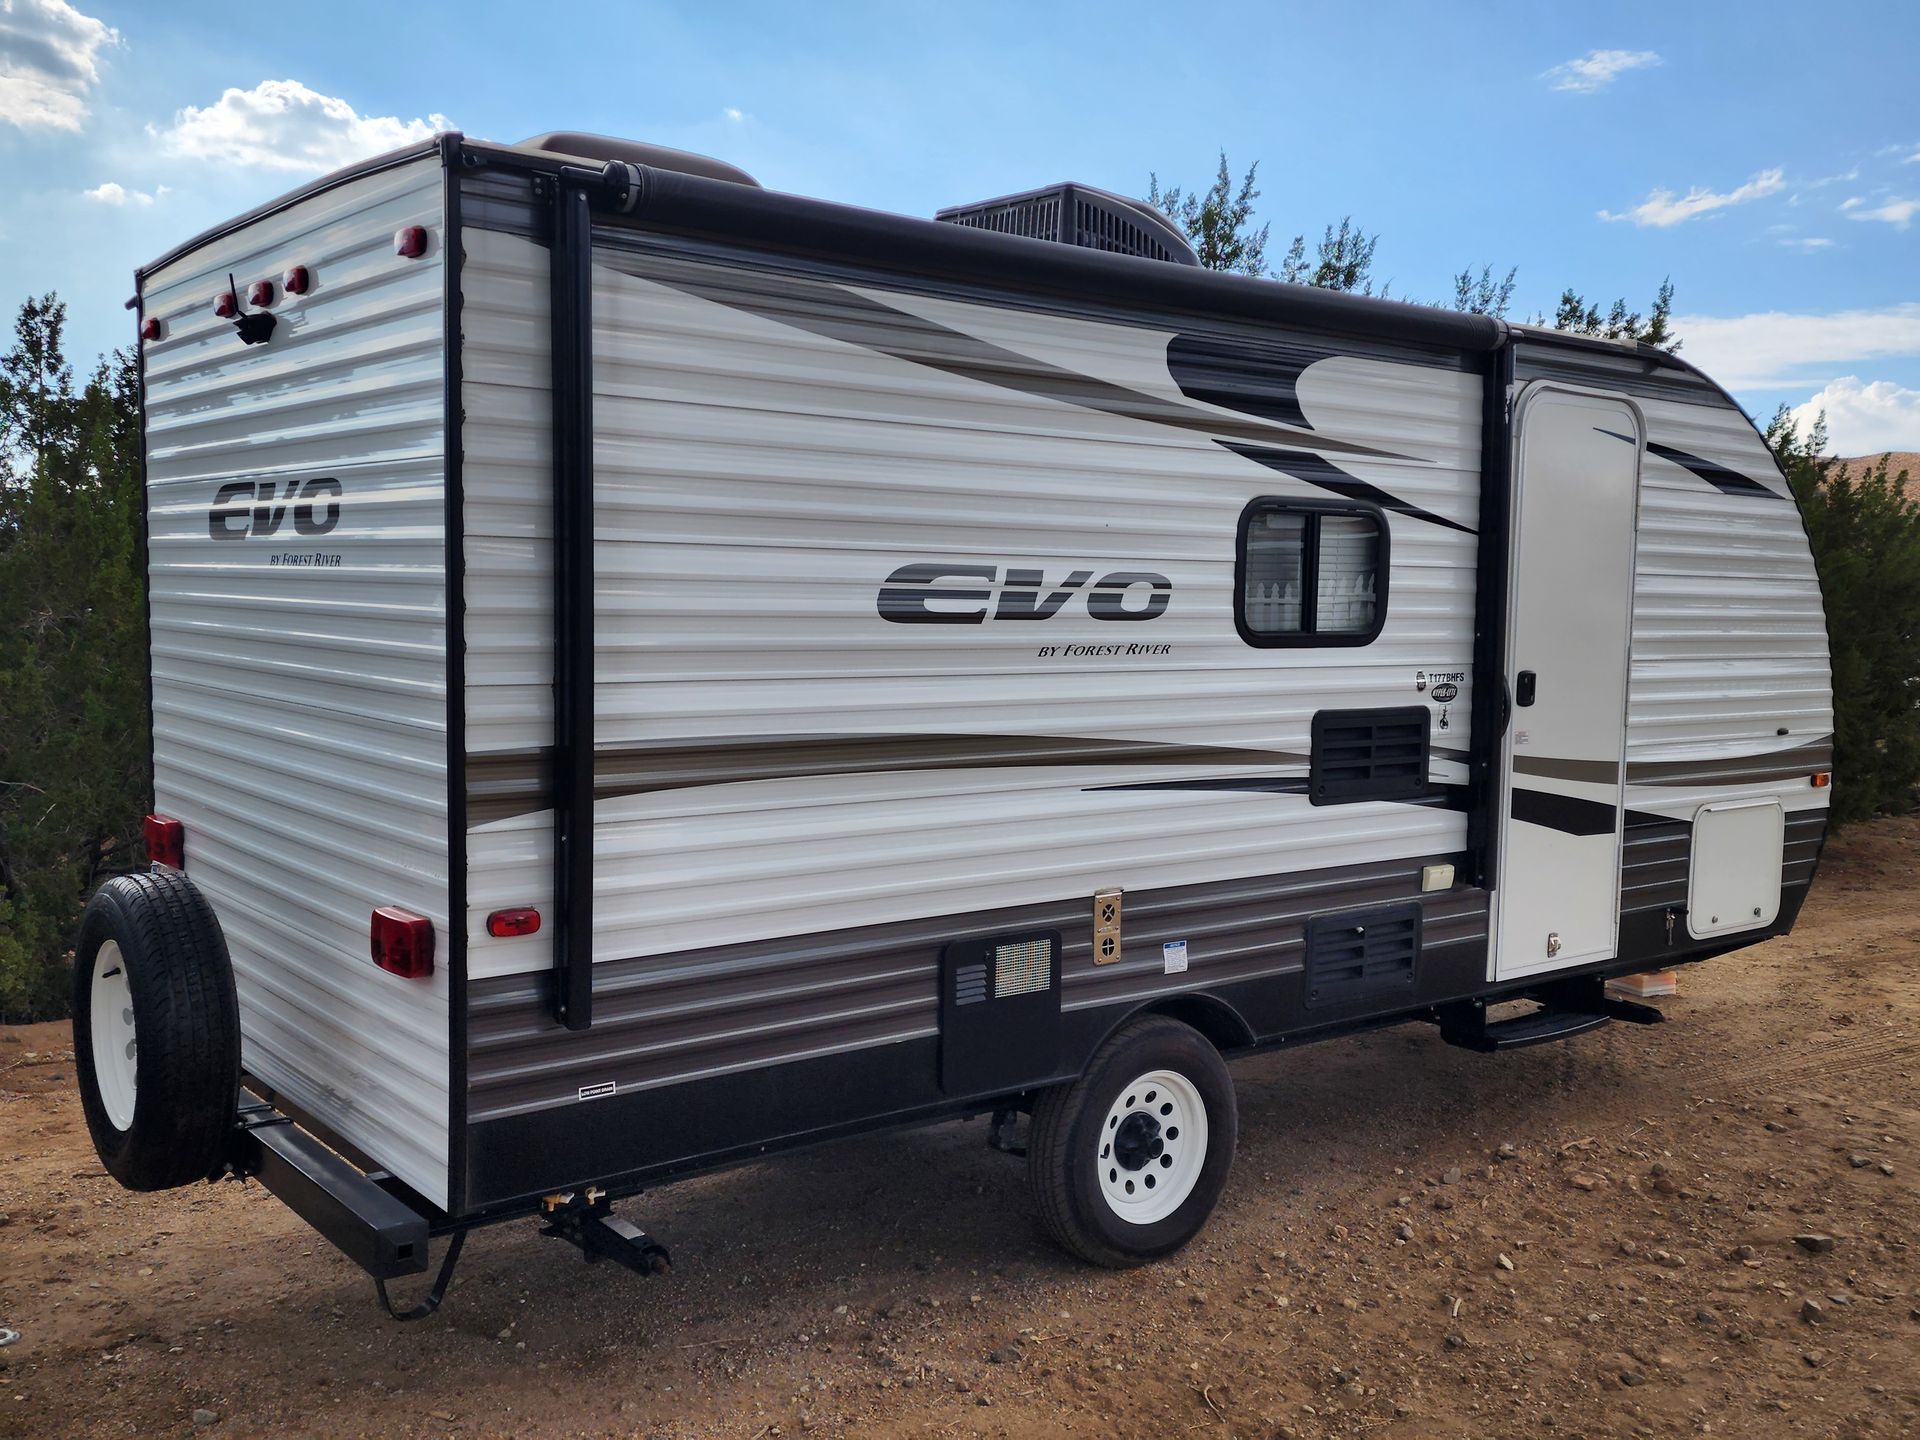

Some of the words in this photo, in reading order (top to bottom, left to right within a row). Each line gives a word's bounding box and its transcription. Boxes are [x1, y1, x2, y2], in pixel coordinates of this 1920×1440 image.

[209, 477, 343, 541] EVO
[314, 553, 342, 567] RIVER
[877, 563, 1172, 624] EVO
[1063, 644, 1125, 657] FOREST
[1125, 643, 1172, 655] RIVER
[1429, 672, 1465, 683] T177BHFS
